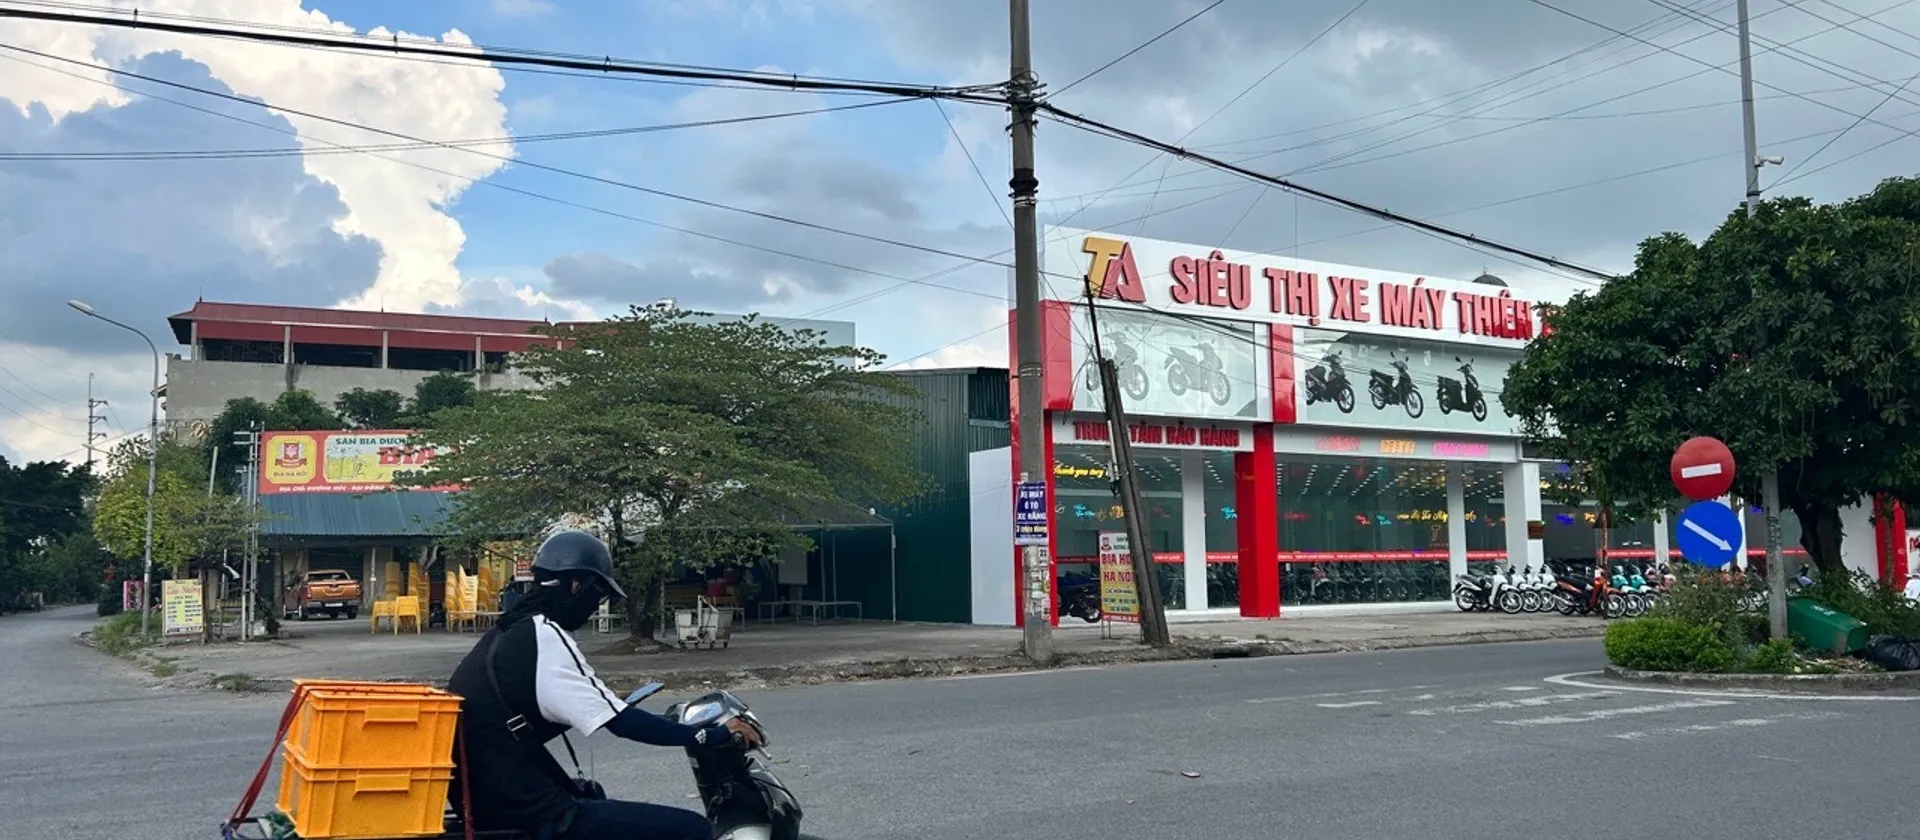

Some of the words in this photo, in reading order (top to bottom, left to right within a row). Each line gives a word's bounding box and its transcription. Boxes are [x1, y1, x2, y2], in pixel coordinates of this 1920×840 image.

[1083, 237, 1146, 303] TA
[1171, 249, 1251, 309] SIÊU
[1264, 267, 1320, 326] THỊ
[1328, 276, 1370, 322] XE
[1380, 277, 1446, 330] MÁY
[1452, 289, 1532, 340] THIÊN
[360, 437, 376, 445] BIA
[1129, 420, 1163, 444] TÂM
[1166, 420, 1196, 445] BẢO
[1200, 425, 1240, 447] HÀNH
[1101, 553, 1117, 565] BIA
